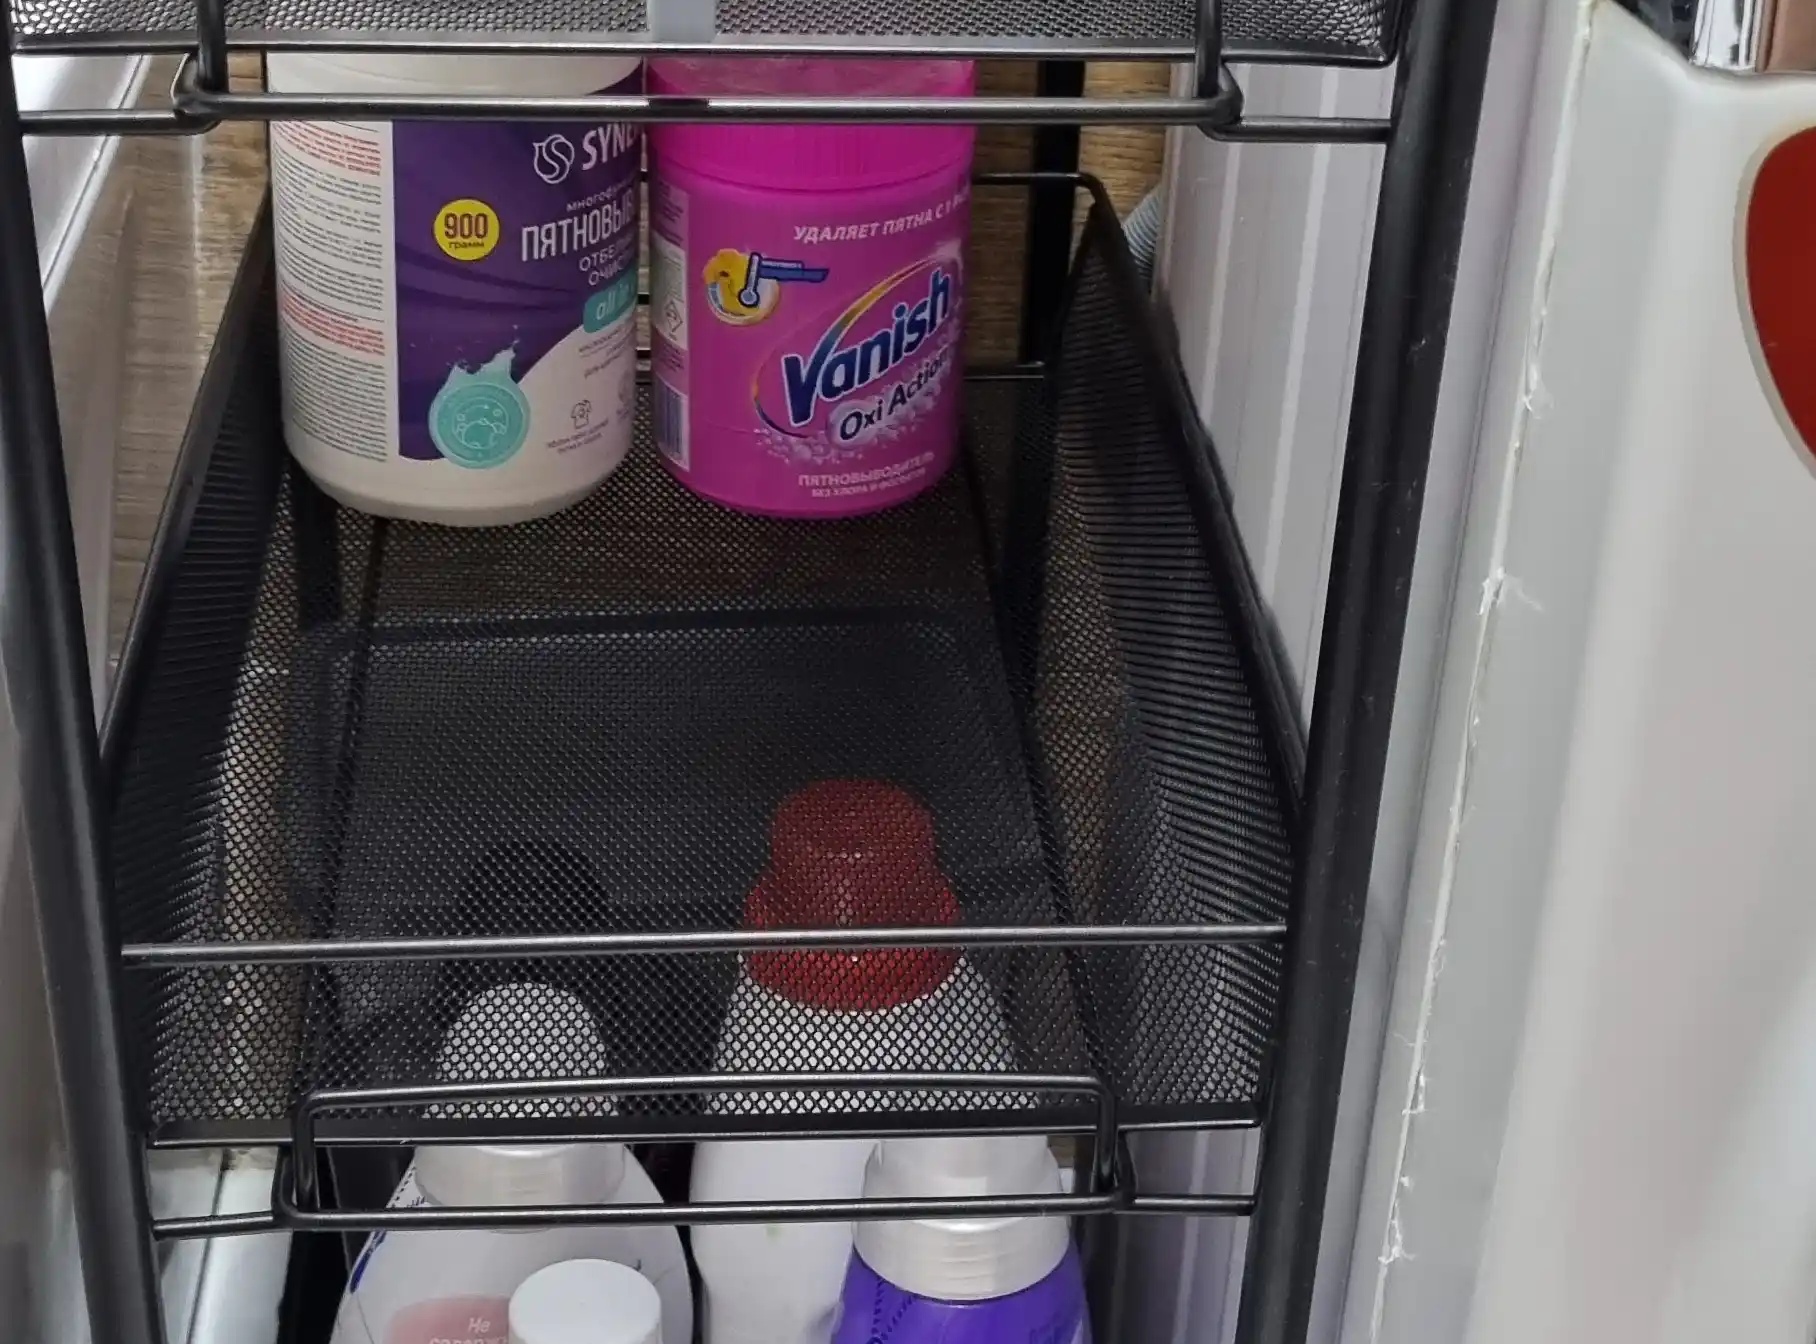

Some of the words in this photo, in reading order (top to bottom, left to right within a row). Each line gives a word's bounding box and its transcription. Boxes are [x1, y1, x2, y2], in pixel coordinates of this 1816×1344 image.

[444, 212, 489, 239] 900
[793, 222, 881, 245] УДАЛЯЕТ
[882, 208, 934, 236] ПЯТНА
[781, 262, 952, 428] Vanish
[840, 398, 883, 441] Oxi
[888, 346, 950, 416] Action
[468, 1317, 491, 1334] Не
